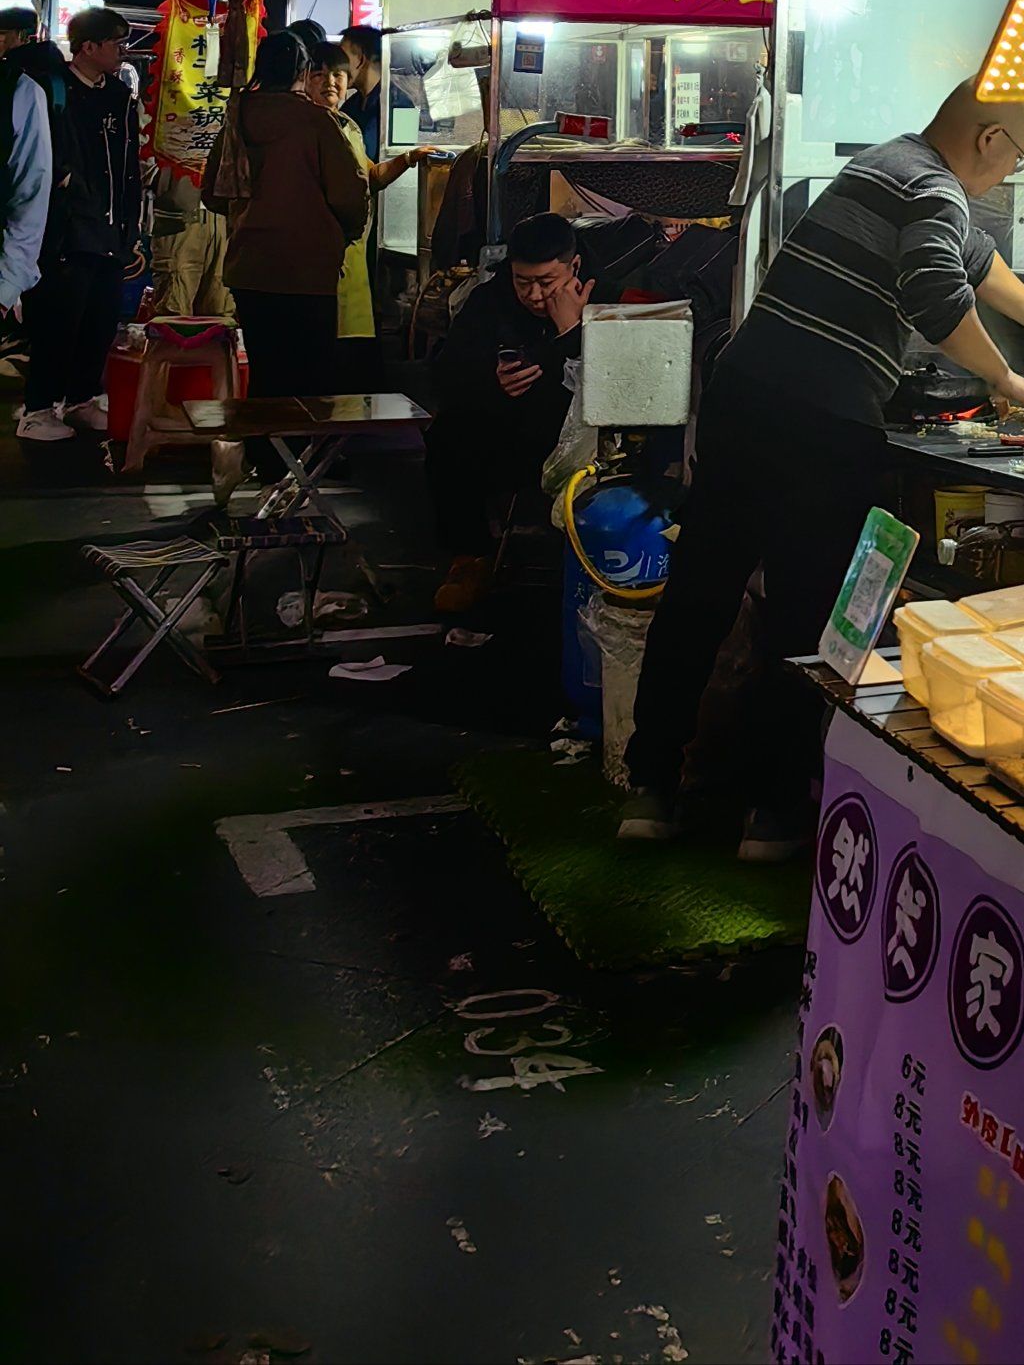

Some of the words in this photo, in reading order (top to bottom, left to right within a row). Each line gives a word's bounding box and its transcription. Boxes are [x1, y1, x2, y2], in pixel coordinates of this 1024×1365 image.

[901, 1054, 925, 1096] 6元
[894, 1094, 921, 1135] 8元
[894, 1132, 921, 1174] 8元
[894, 1170, 922, 1212] 8元
[892, 1209, 921, 1252] 8元
[889, 1249, 919, 1293] 8元
[885, 1289, 917, 1334] 8元
[880, 1329, 914, 1365] 8元
